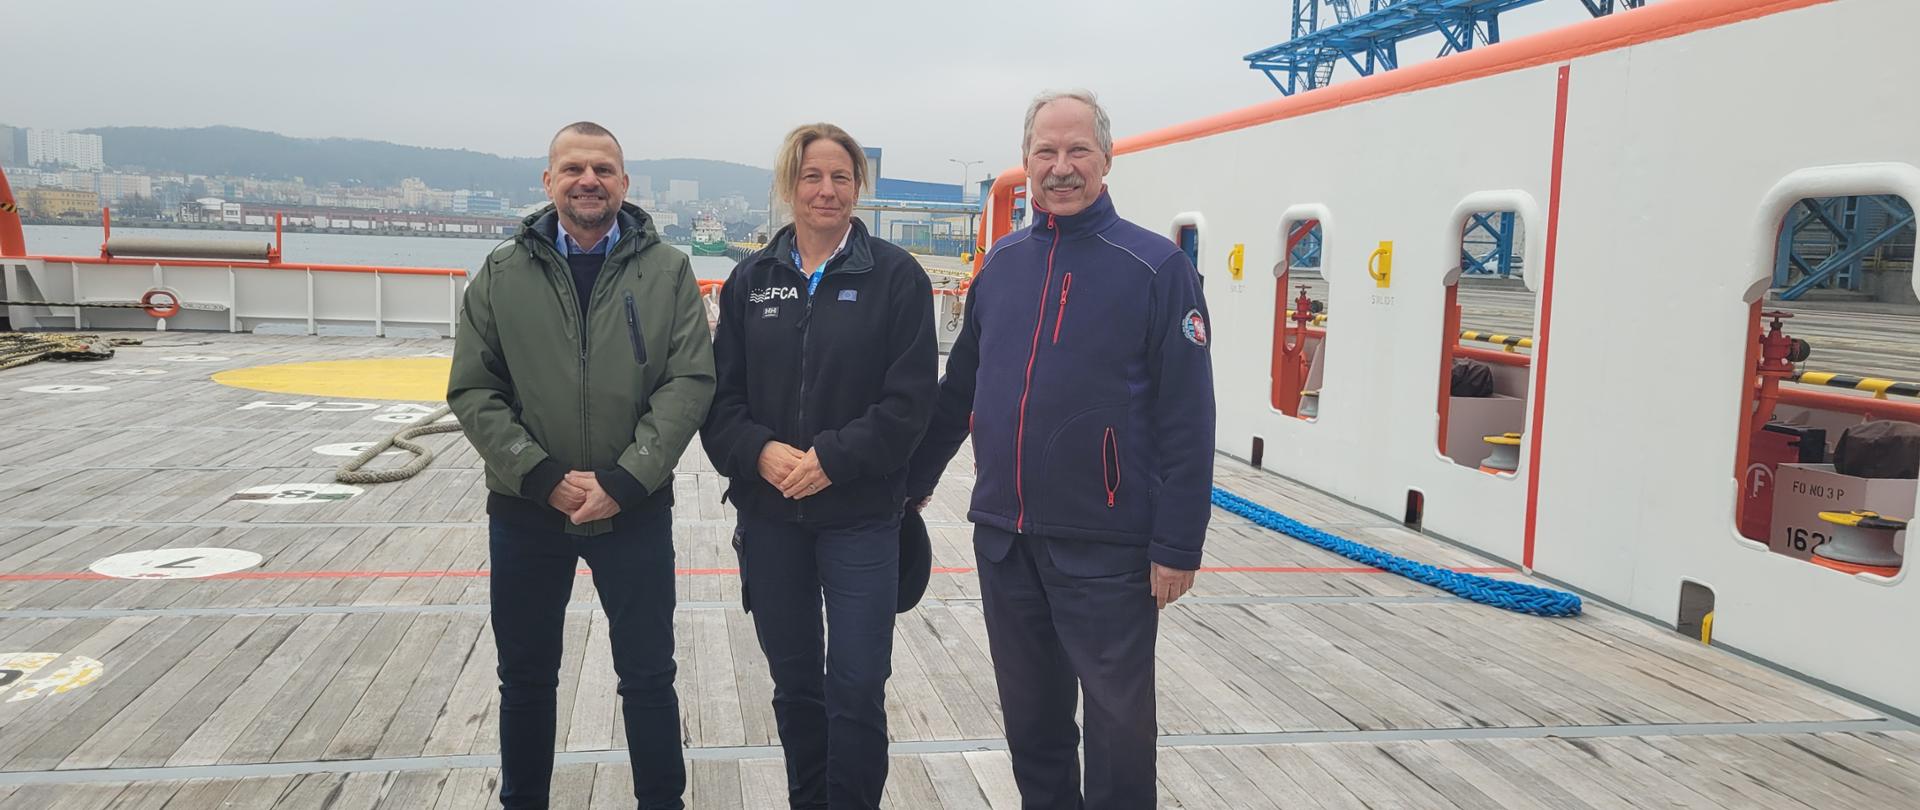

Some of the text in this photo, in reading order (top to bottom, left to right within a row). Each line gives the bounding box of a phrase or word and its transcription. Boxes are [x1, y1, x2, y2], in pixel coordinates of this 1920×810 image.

[764, 286, 799, 300] EFCA
[1752, 470, 1766, 497] F
[278, 489, 316, 499] 8
[1809, 485, 1824, 498] NO
[1827, 487, 1834, 499] 3
[1837, 489, 1845, 501] P
[1786, 526, 1833, 554] 162
